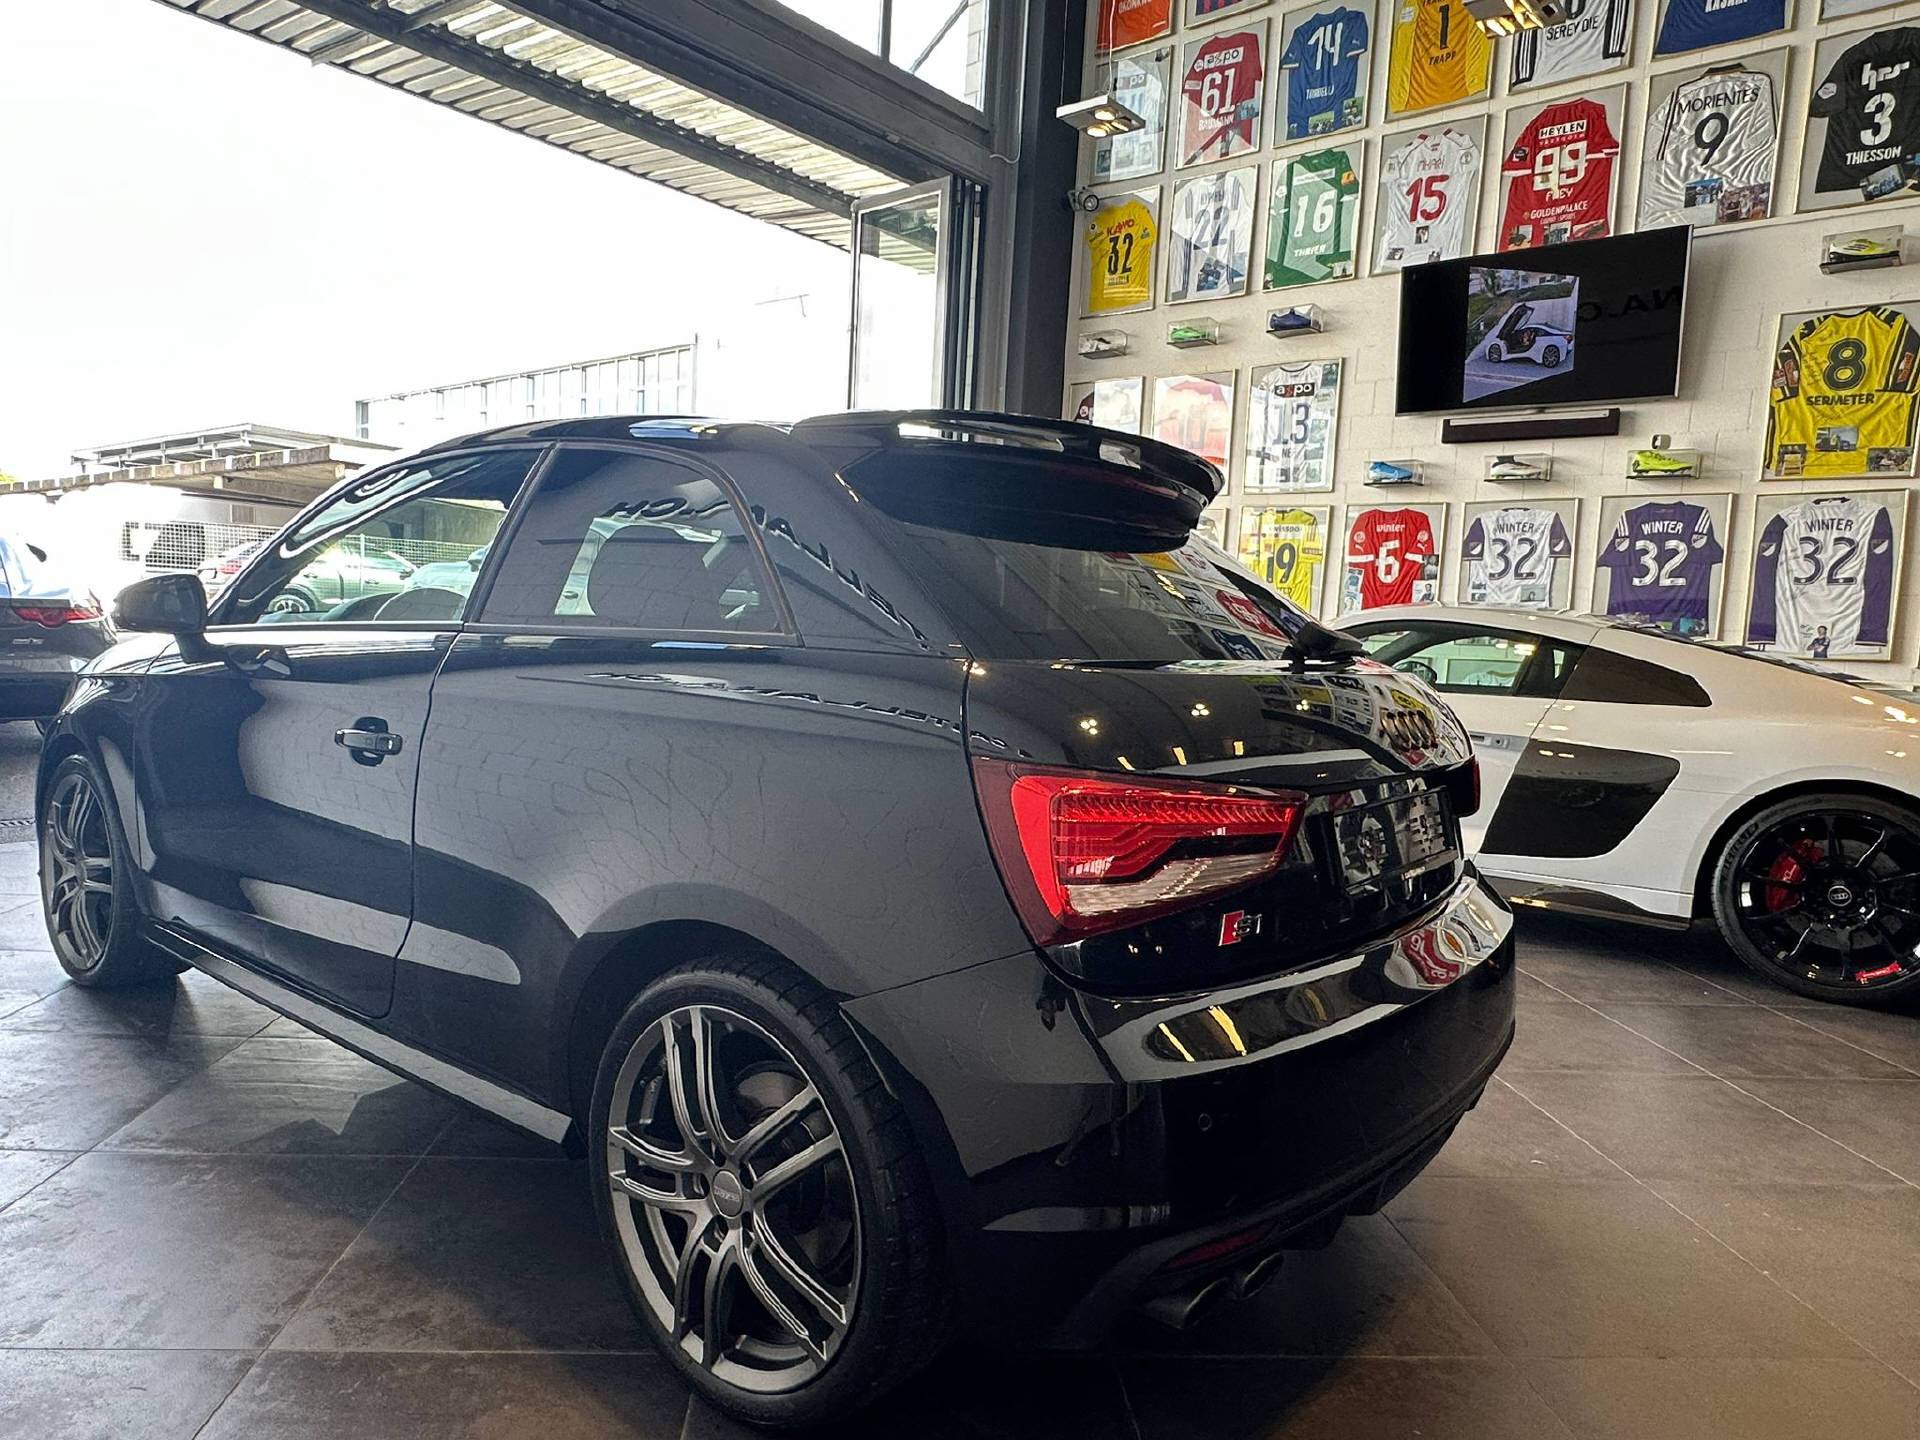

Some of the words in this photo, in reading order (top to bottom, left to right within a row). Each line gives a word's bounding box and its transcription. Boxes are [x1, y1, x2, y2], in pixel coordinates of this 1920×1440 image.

[1308, 22, 1344, 70] 14
[1439, 4, 1449, 50] 1
[1546, 21, 1578, 41] SEREY
[1581, 15, 1599, 32] DIE
[1429, 50, 1456, 65] TRAPP
[1201, 67, 1236, 117] 61
[1677, 87, 1761, 114] MORIENTES
[1540, 121, 1585, 138] HEYLEN
[1694, 112, 1729, 166] 9
[1860, 92, 1896, 146] 3
[1845, 146, 1902, 166] THIESSON
[1294, 189, 1338, 238] 16
[1405, 174, 1450, 223] 15
[1545, 187, 1573, 202] FEY
[1107, 233, 1134, 275] 32
[1823, 338, 1866, 391] 8
[1276, 384, 1313, 397] aspo
[1806, 392, 1875, 406] SERMETER
[1272, 403, 1310, 445] 13
[1376, 523, 1405, 533] winter
[1496, 521, 1535, 534] WINTER
[1641, 520, 1684, 535] WINTER
[1806, 518, 1854, 533] WINTER
[1266, 542, 1297, 584] 19
[1376, 540, 1400, 584] 6
[1488, 537, 1538, 581] 32
[1632, 539, 1689, 587] 32
[1794, 536, 1858, 585] 32
